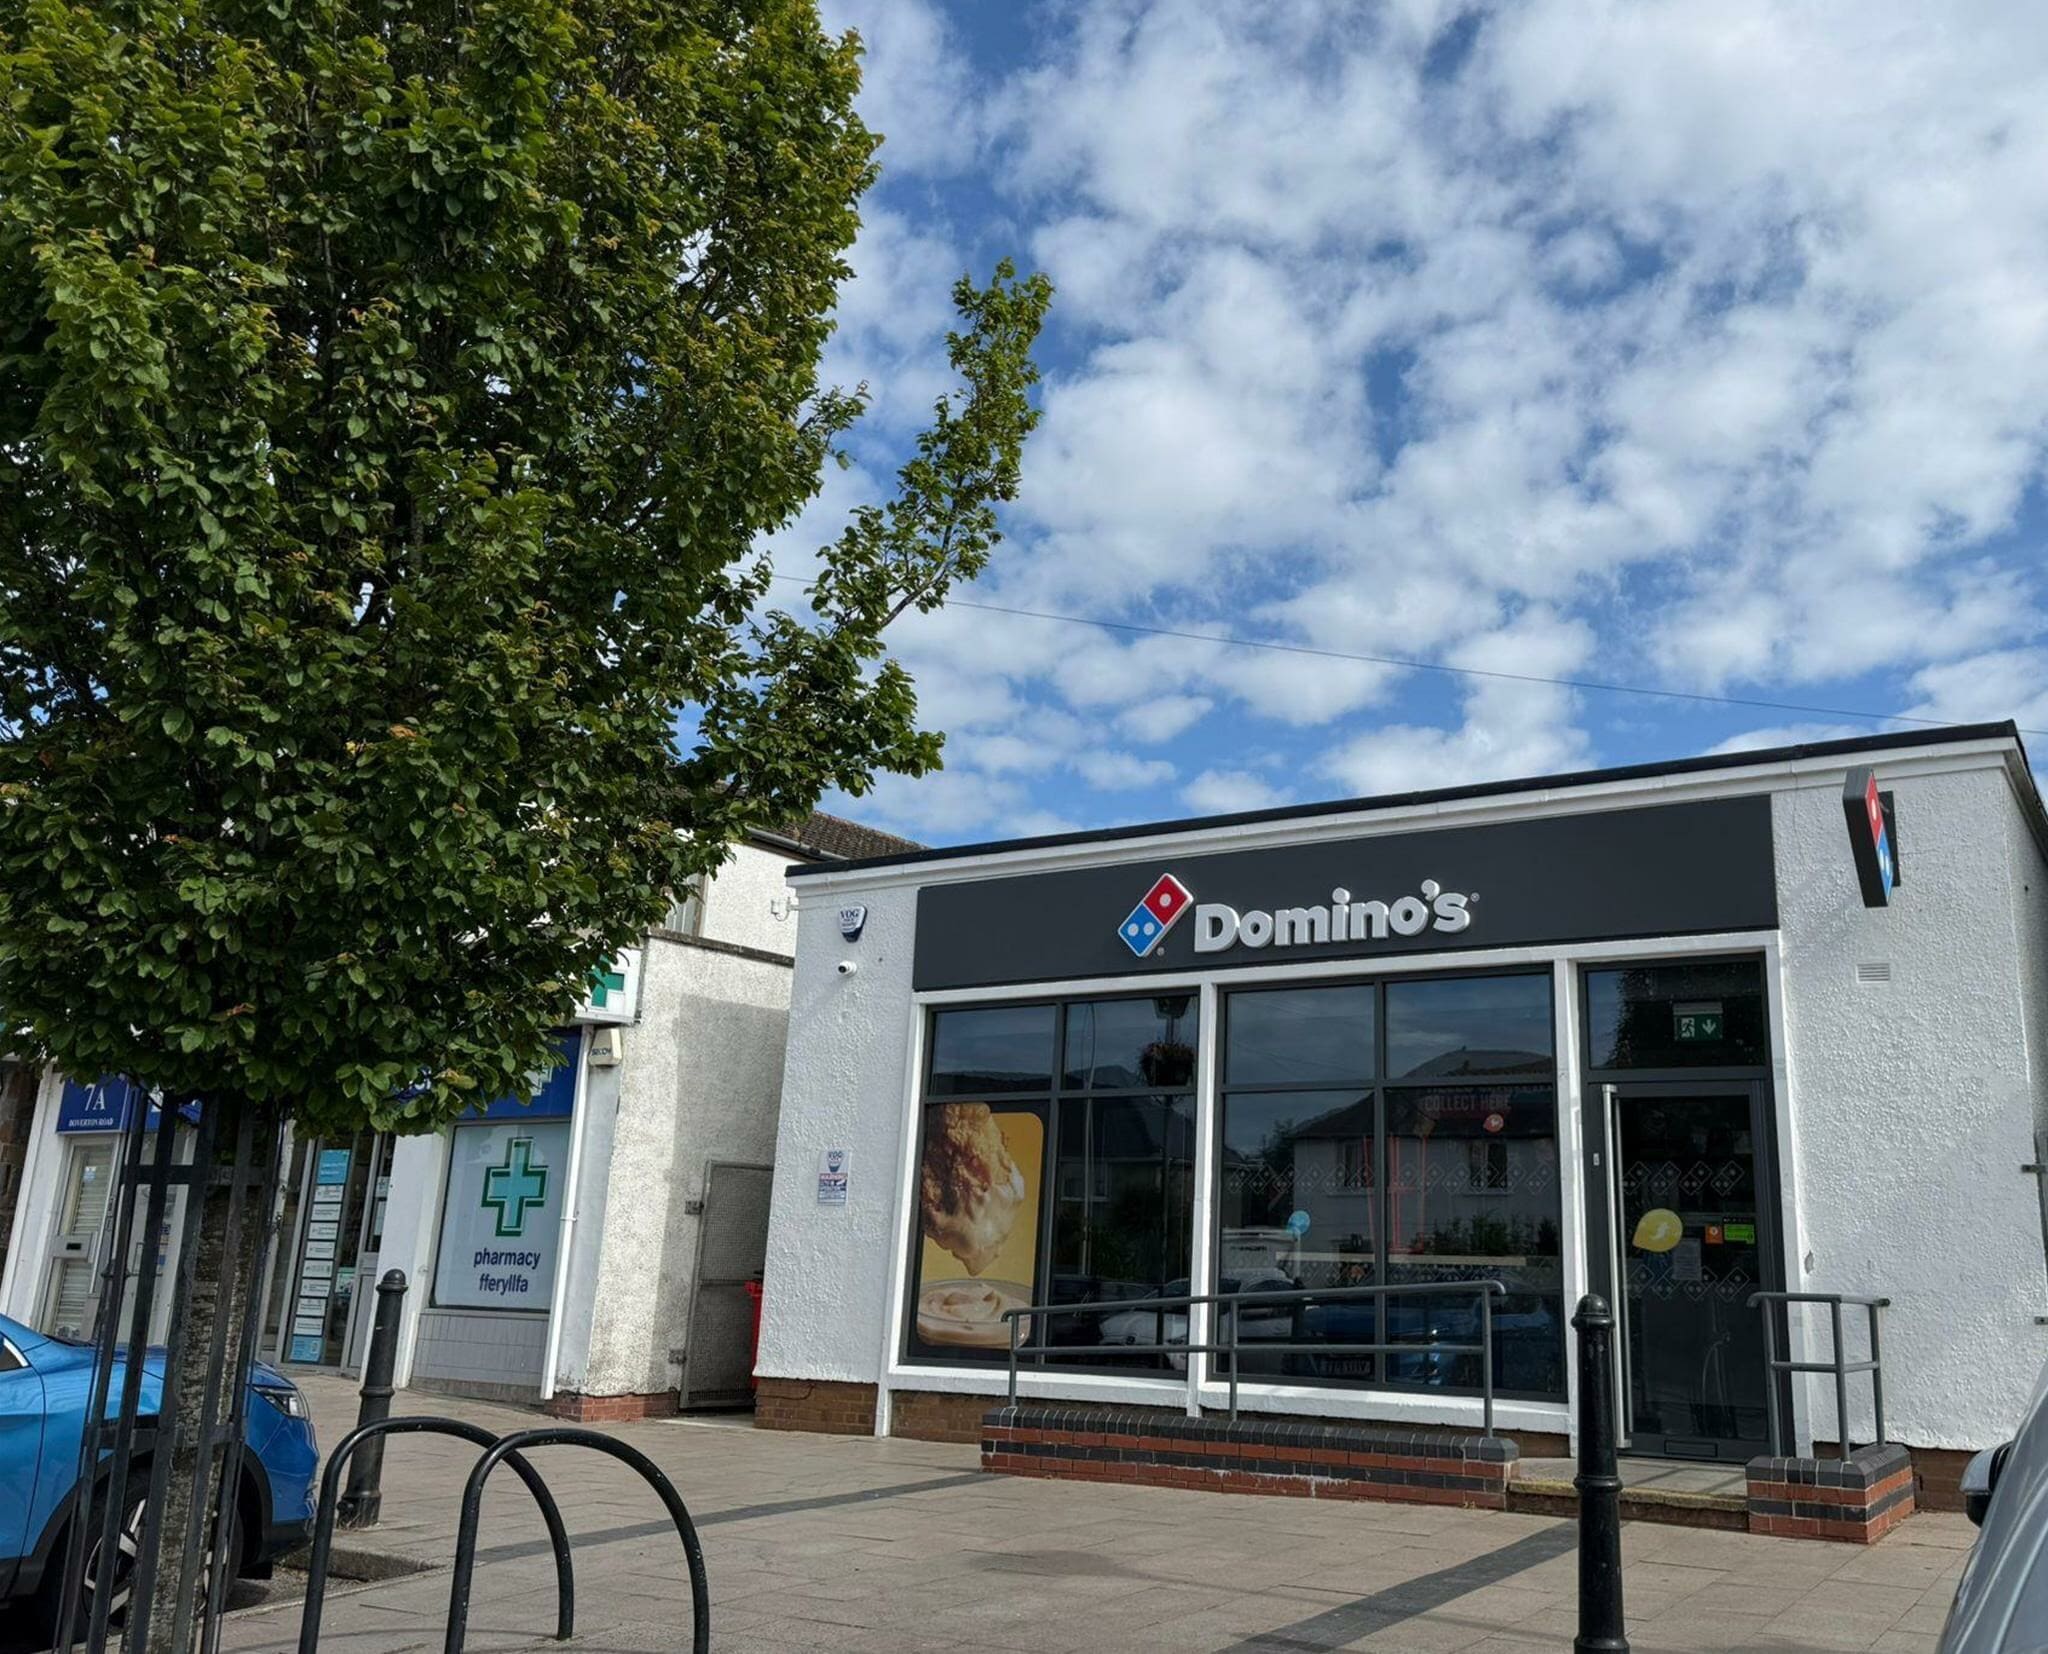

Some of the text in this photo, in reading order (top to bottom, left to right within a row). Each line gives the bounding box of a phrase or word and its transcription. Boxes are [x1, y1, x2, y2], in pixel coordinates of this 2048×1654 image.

[1194, 879, 1471, 953] Domino's
[84, 1083, 105, 1111] 7A
[473, 1248, 541, 1270] pharmacy
[479, 1273, 529, 1296] fferyllfa
